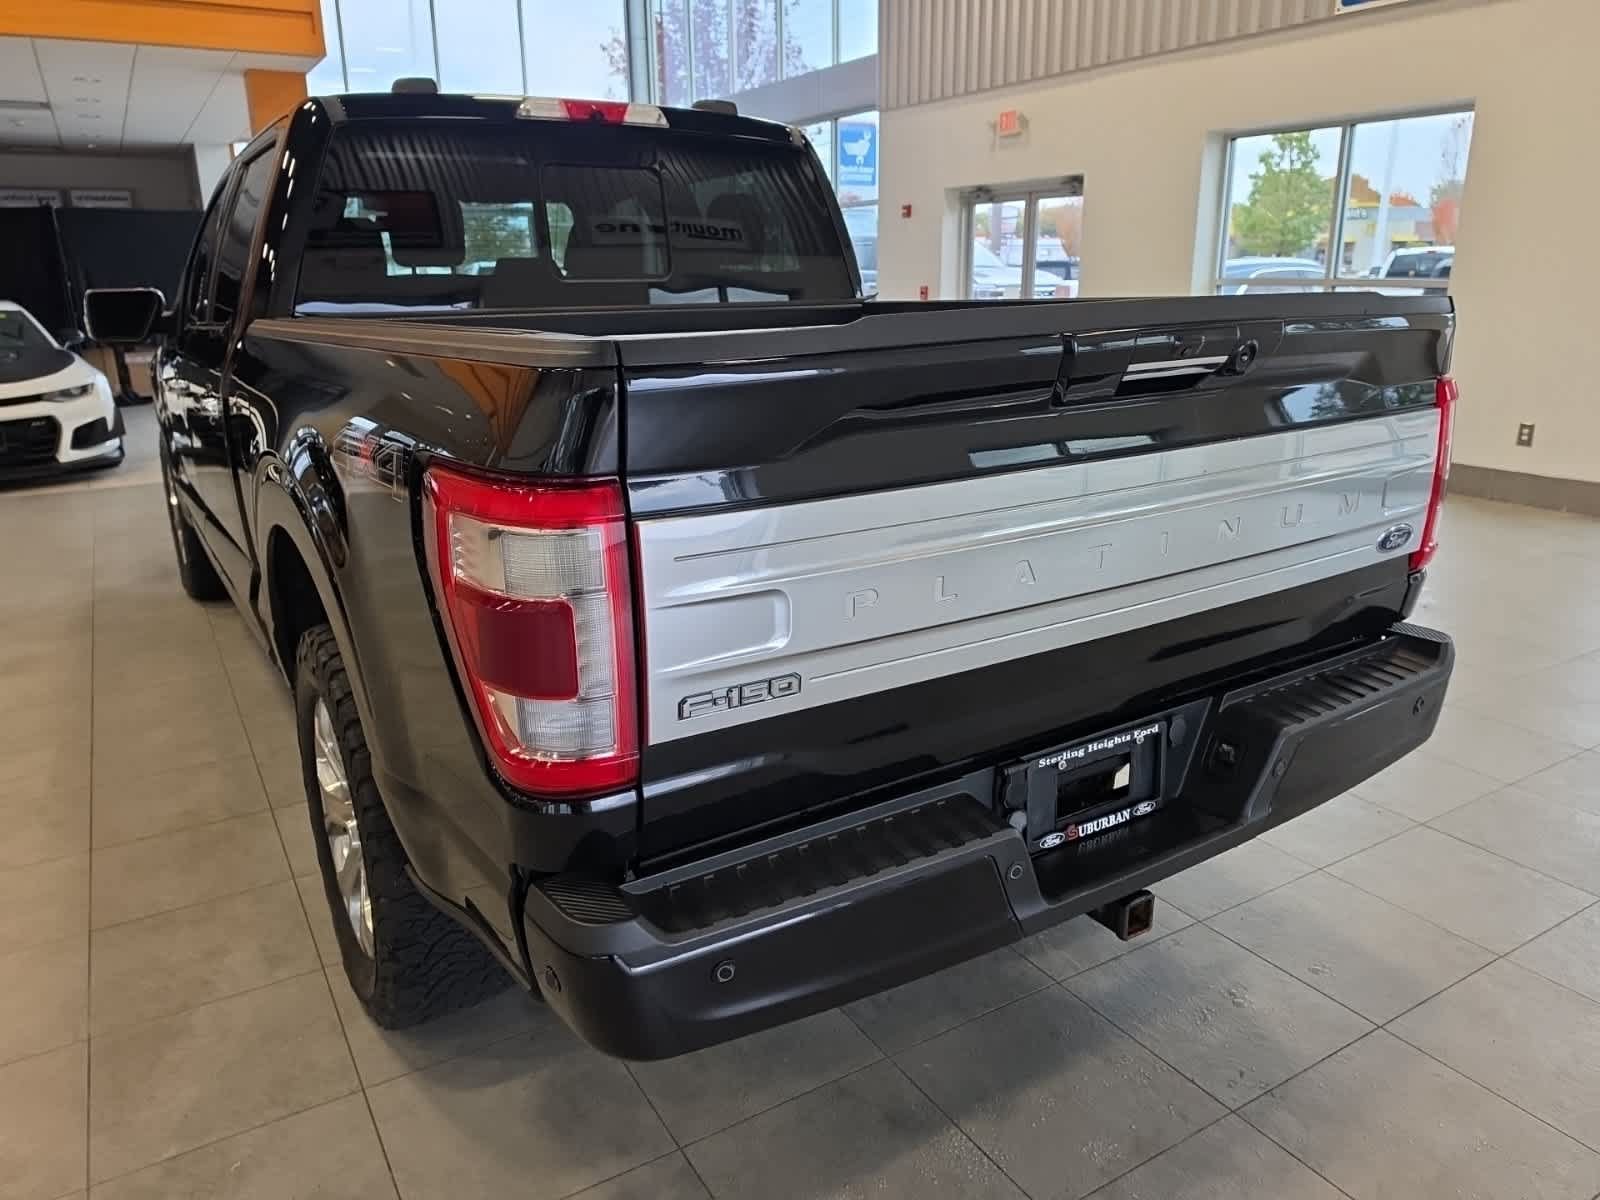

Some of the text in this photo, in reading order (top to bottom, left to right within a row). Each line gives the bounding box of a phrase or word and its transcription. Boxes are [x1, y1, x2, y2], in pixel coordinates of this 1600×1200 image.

[845, 490, 1361, 619] PLATINUM
[678, 672, 801, 720] F-150
[1038, 724, 1159, 768] Sterling Heights Ford
[1065, 808, 1131, 841] SUBURBAN
